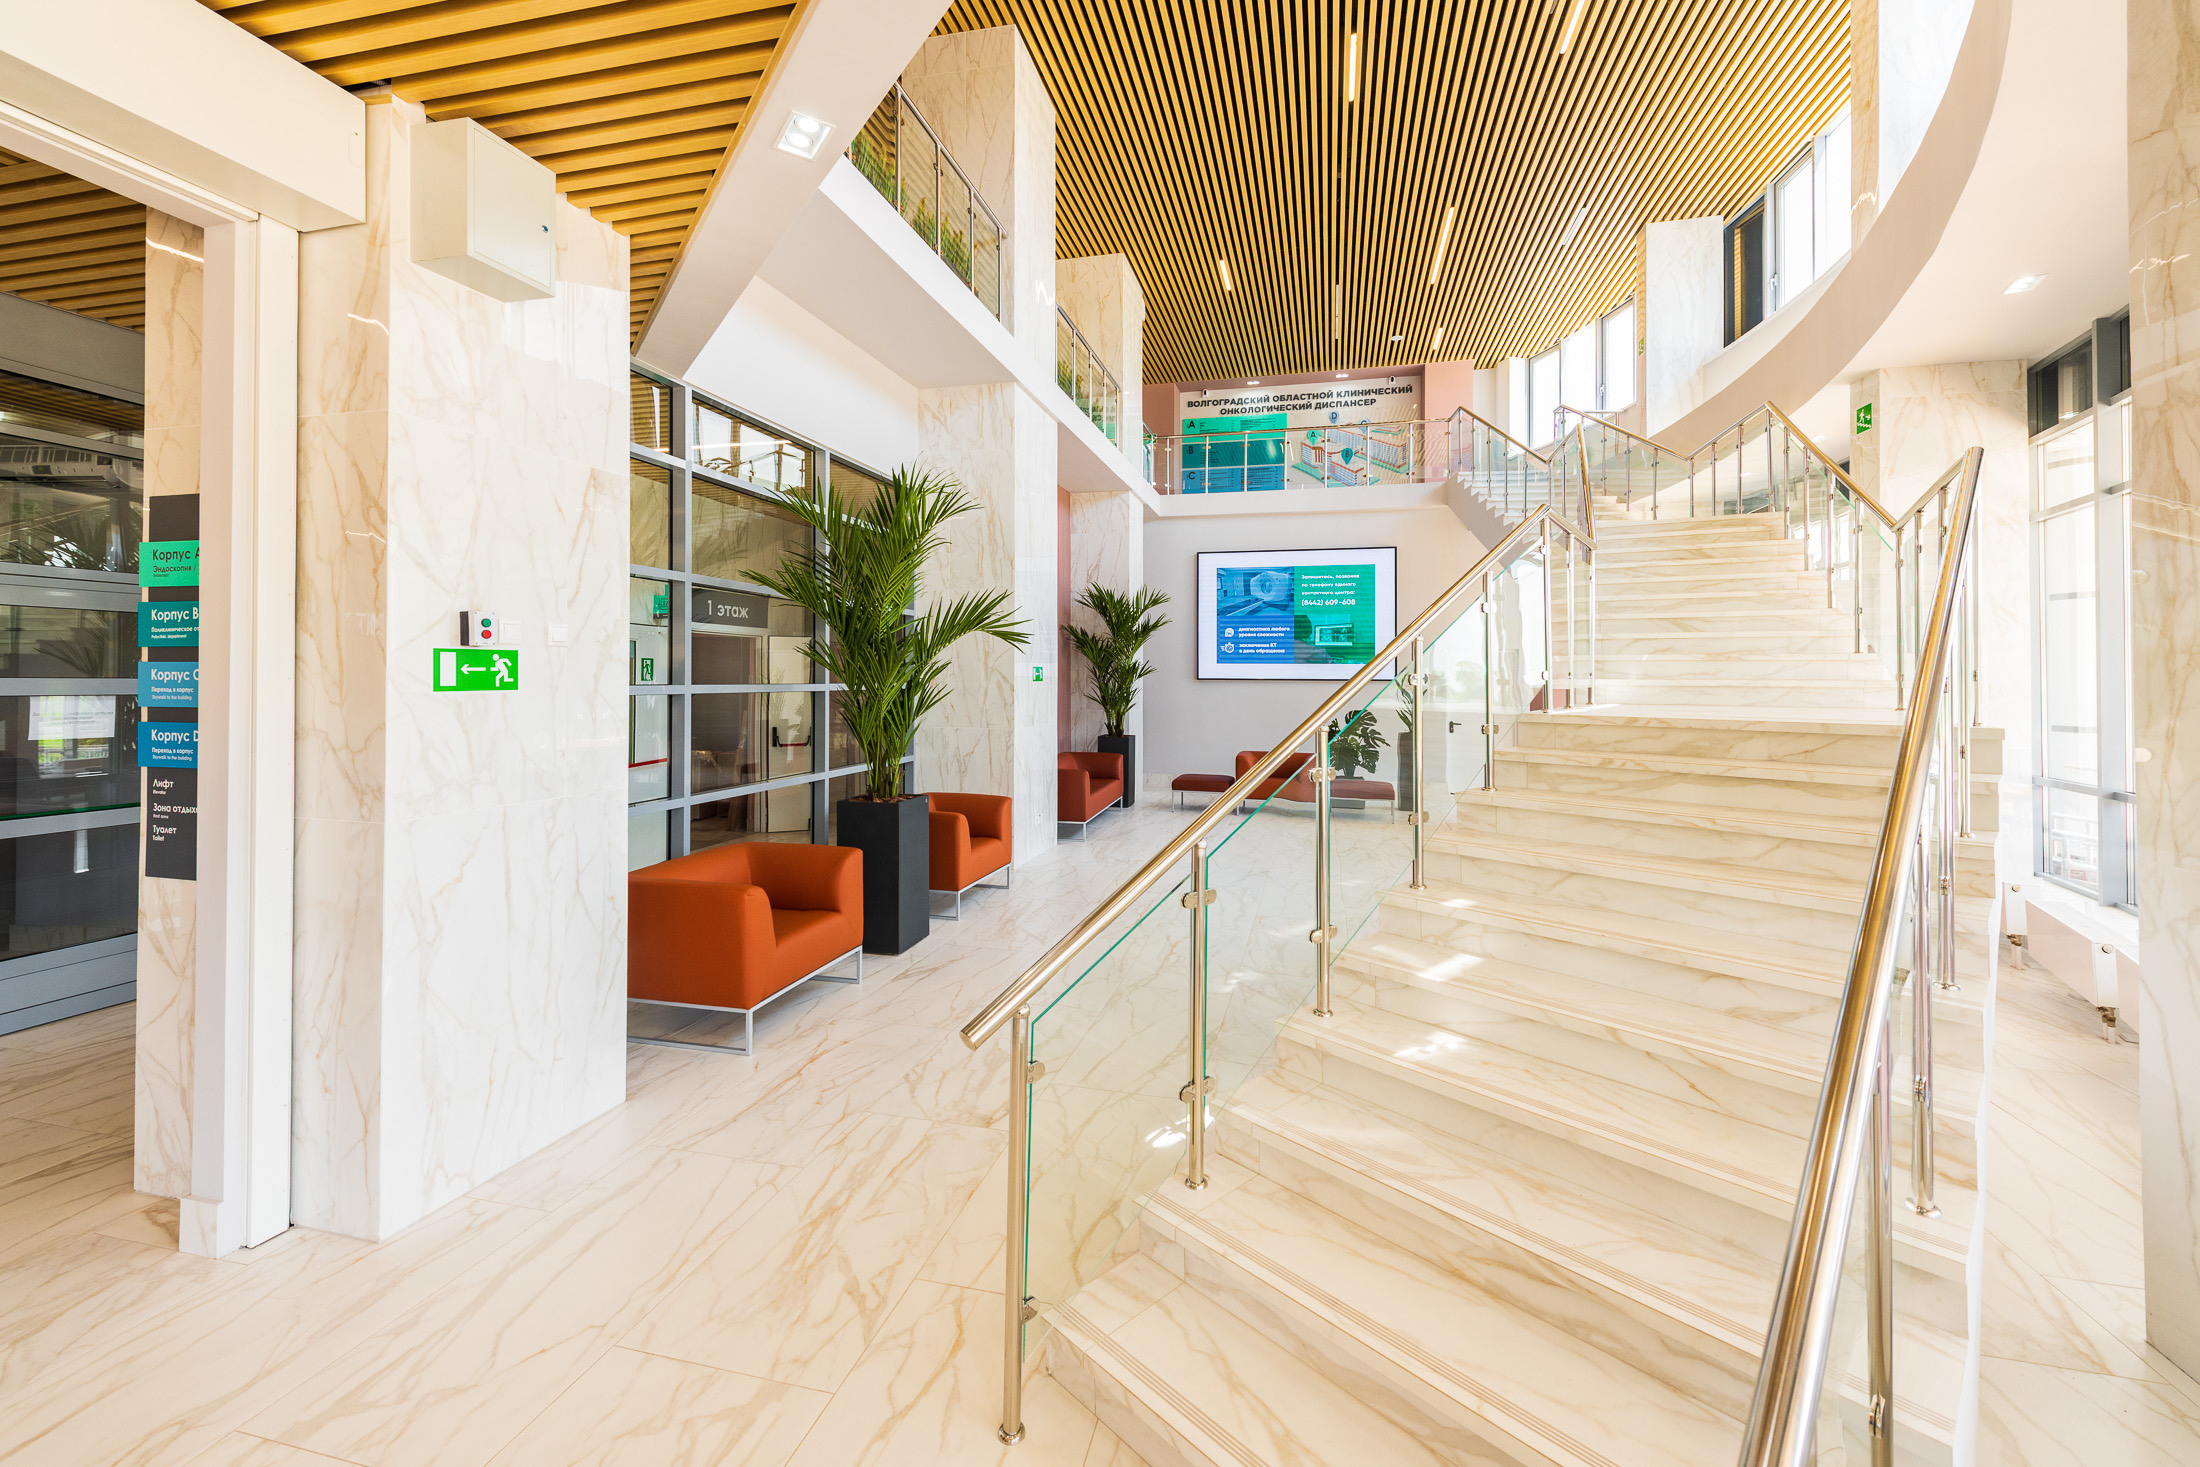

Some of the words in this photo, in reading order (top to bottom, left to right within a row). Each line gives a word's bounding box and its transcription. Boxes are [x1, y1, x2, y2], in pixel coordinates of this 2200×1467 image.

[1187, 395, 1270, 408] ВОЛГОГРАДСКИЙ
[1272, 390, 1334, 402] ОБЛАСТНОЙ
[1336, 384, 1413, 398] КЛИНИЧЕСКИЙ
[1220, 402, 1313, 415] ОНКОЛОГИЧЕСКИЙ
[1314, 398, 1377, 410] ДИСПАНСЕР
[1331, 411, 1338, 420] D
[152, 549, 191, 563] Корпус
[707, 600, 712, 616] 1
[717, 604, 749, 619] этаж
[1301, 599, 1324, 607] (8442)
[1324, 598, 1356, 606] 609-608
[151, 609, 190, 623] Корпус
[151, 669, 190, 684] Корпус
[151, 686, 173, 694] Переход
[151, 729, 190, 744] Корпус
[152, 779, 174, 789] Лифт
[152, 802, 172, 813] Зона
[152, 824, 178, 835] Туалет
